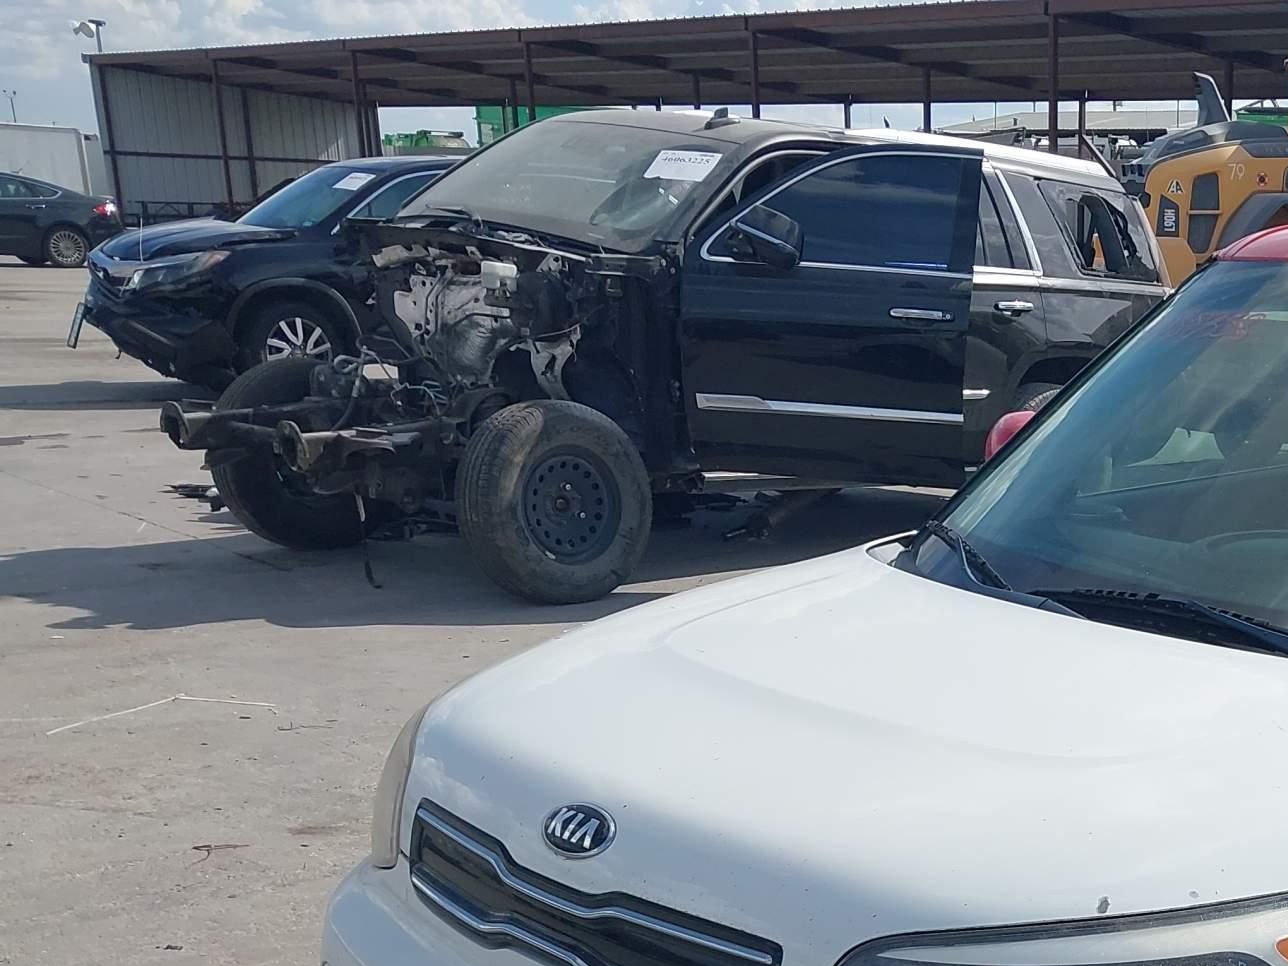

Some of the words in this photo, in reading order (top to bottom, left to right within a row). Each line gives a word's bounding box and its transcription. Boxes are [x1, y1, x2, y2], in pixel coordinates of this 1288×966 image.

[1228, 163, 1246, 181] 79
[1164, 209, 1176, 231] L90H
[547, 807, 600, 849] KIA
